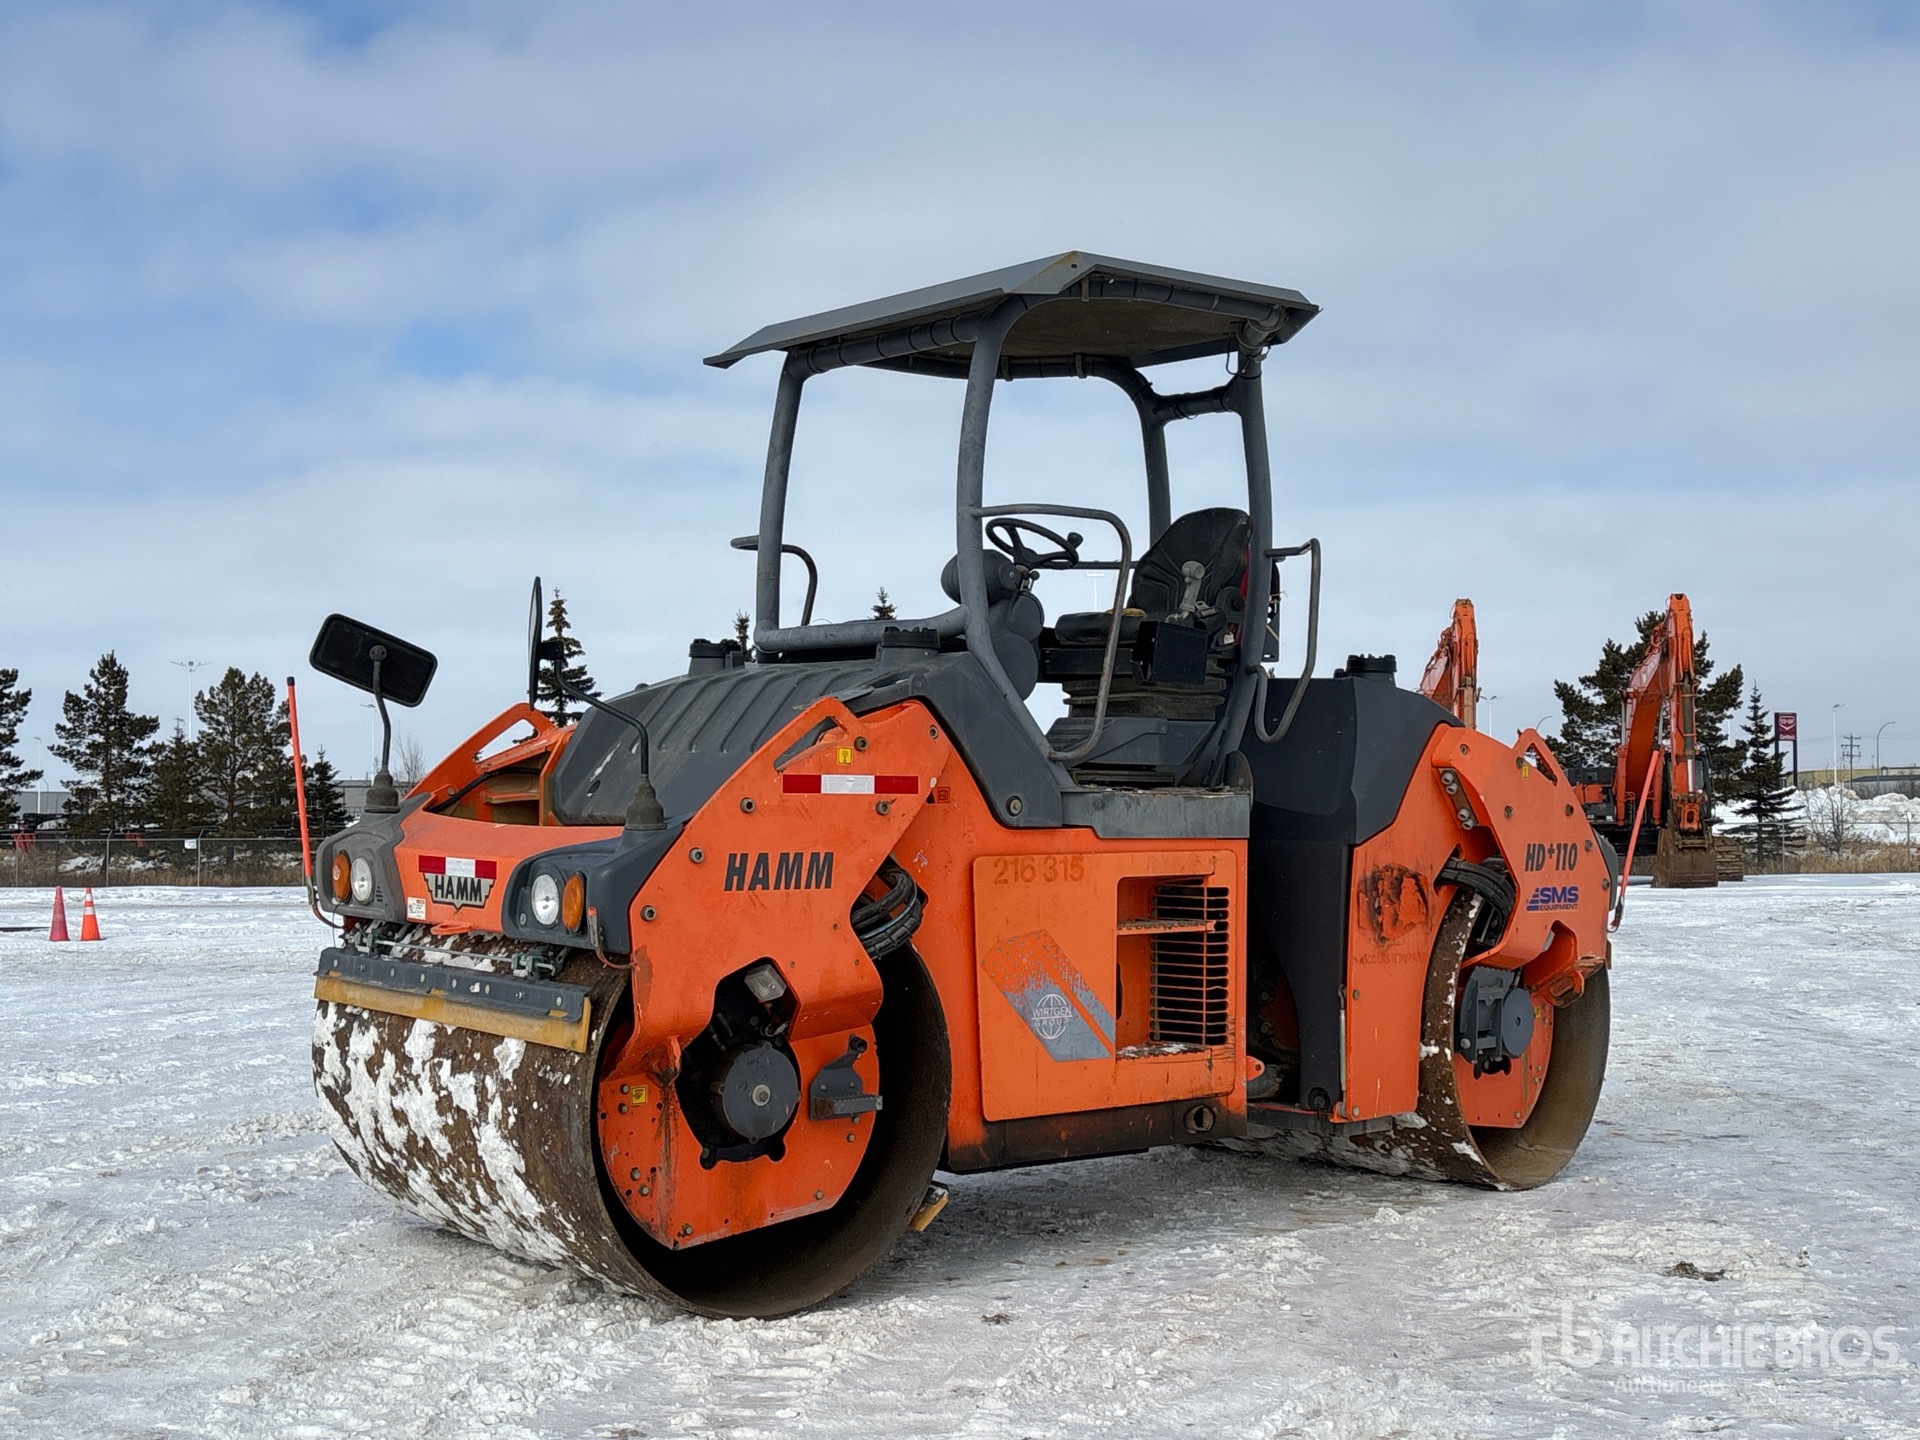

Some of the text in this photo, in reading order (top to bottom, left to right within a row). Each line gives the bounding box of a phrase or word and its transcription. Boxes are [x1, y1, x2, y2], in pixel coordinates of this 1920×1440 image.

[724, 852, 834, 891] HAMM
[994, 855, 1085, 884] 216 315
[434, 875, 482, 902] HAMM
[1540, 886, 1579, 904] SMS
[1540, 903, 1579, 911] EQUIPMENT
[1032, 1006, 1072, 1019] WIRTGEN
